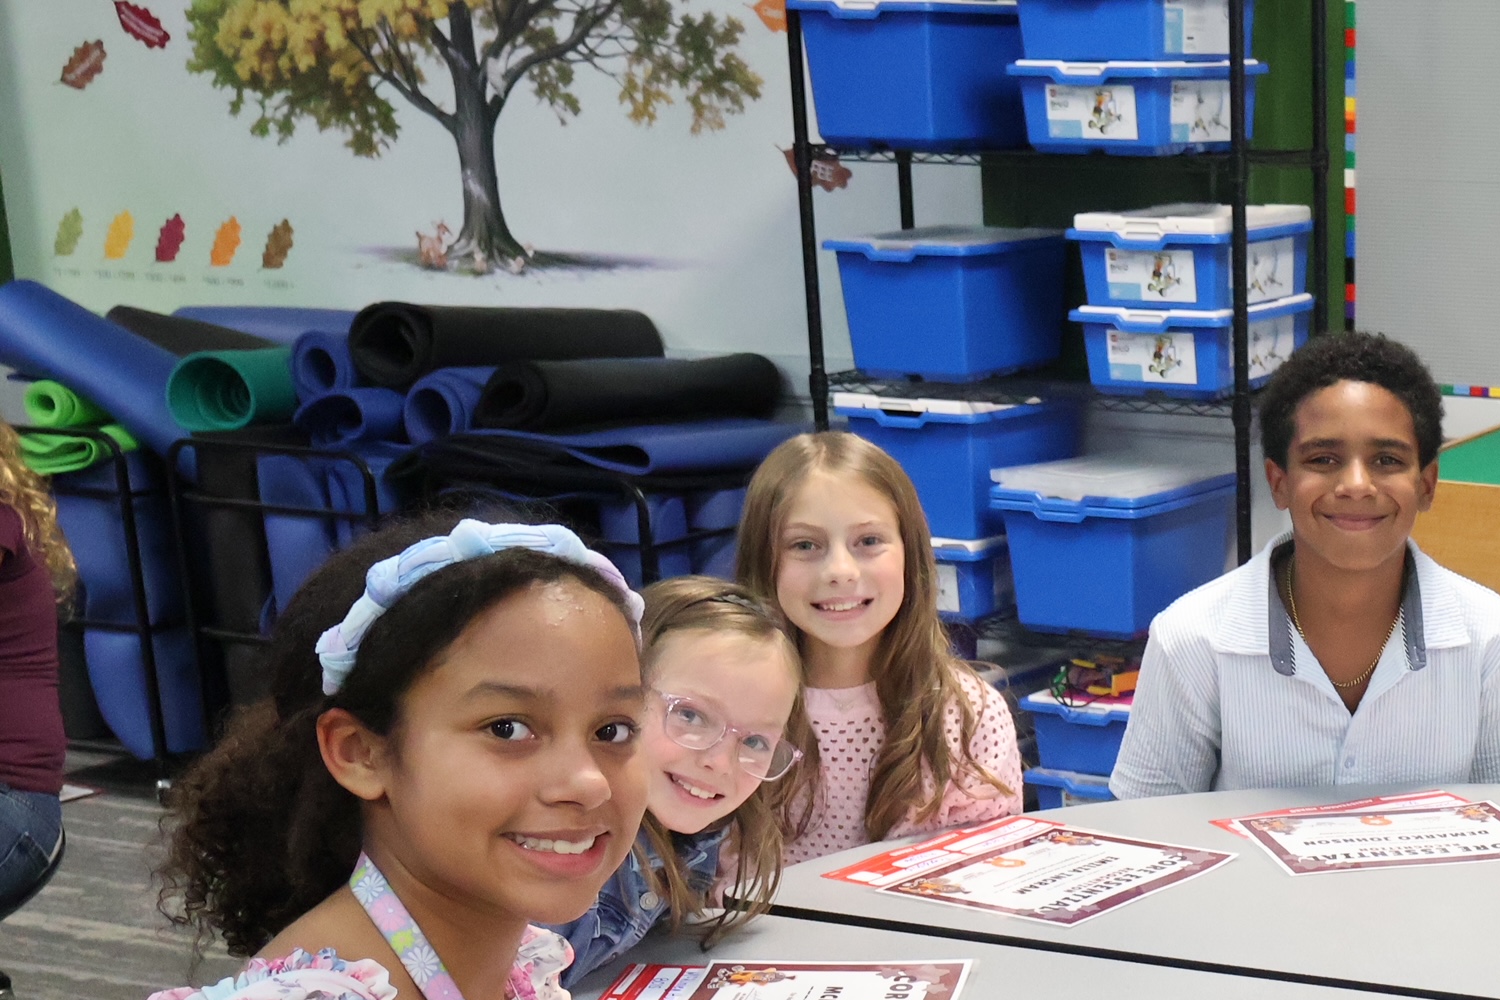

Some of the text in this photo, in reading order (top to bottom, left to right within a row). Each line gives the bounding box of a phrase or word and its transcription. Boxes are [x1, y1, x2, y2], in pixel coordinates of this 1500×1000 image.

[1303, 830, 1490, 847] DEMARKO JOHNSON
[1142, 854, 1188, 875] CORE
[1307, 848, 1450, 863] ESSENTIAL
[1071, 856, 1120, 875] EMILIA
